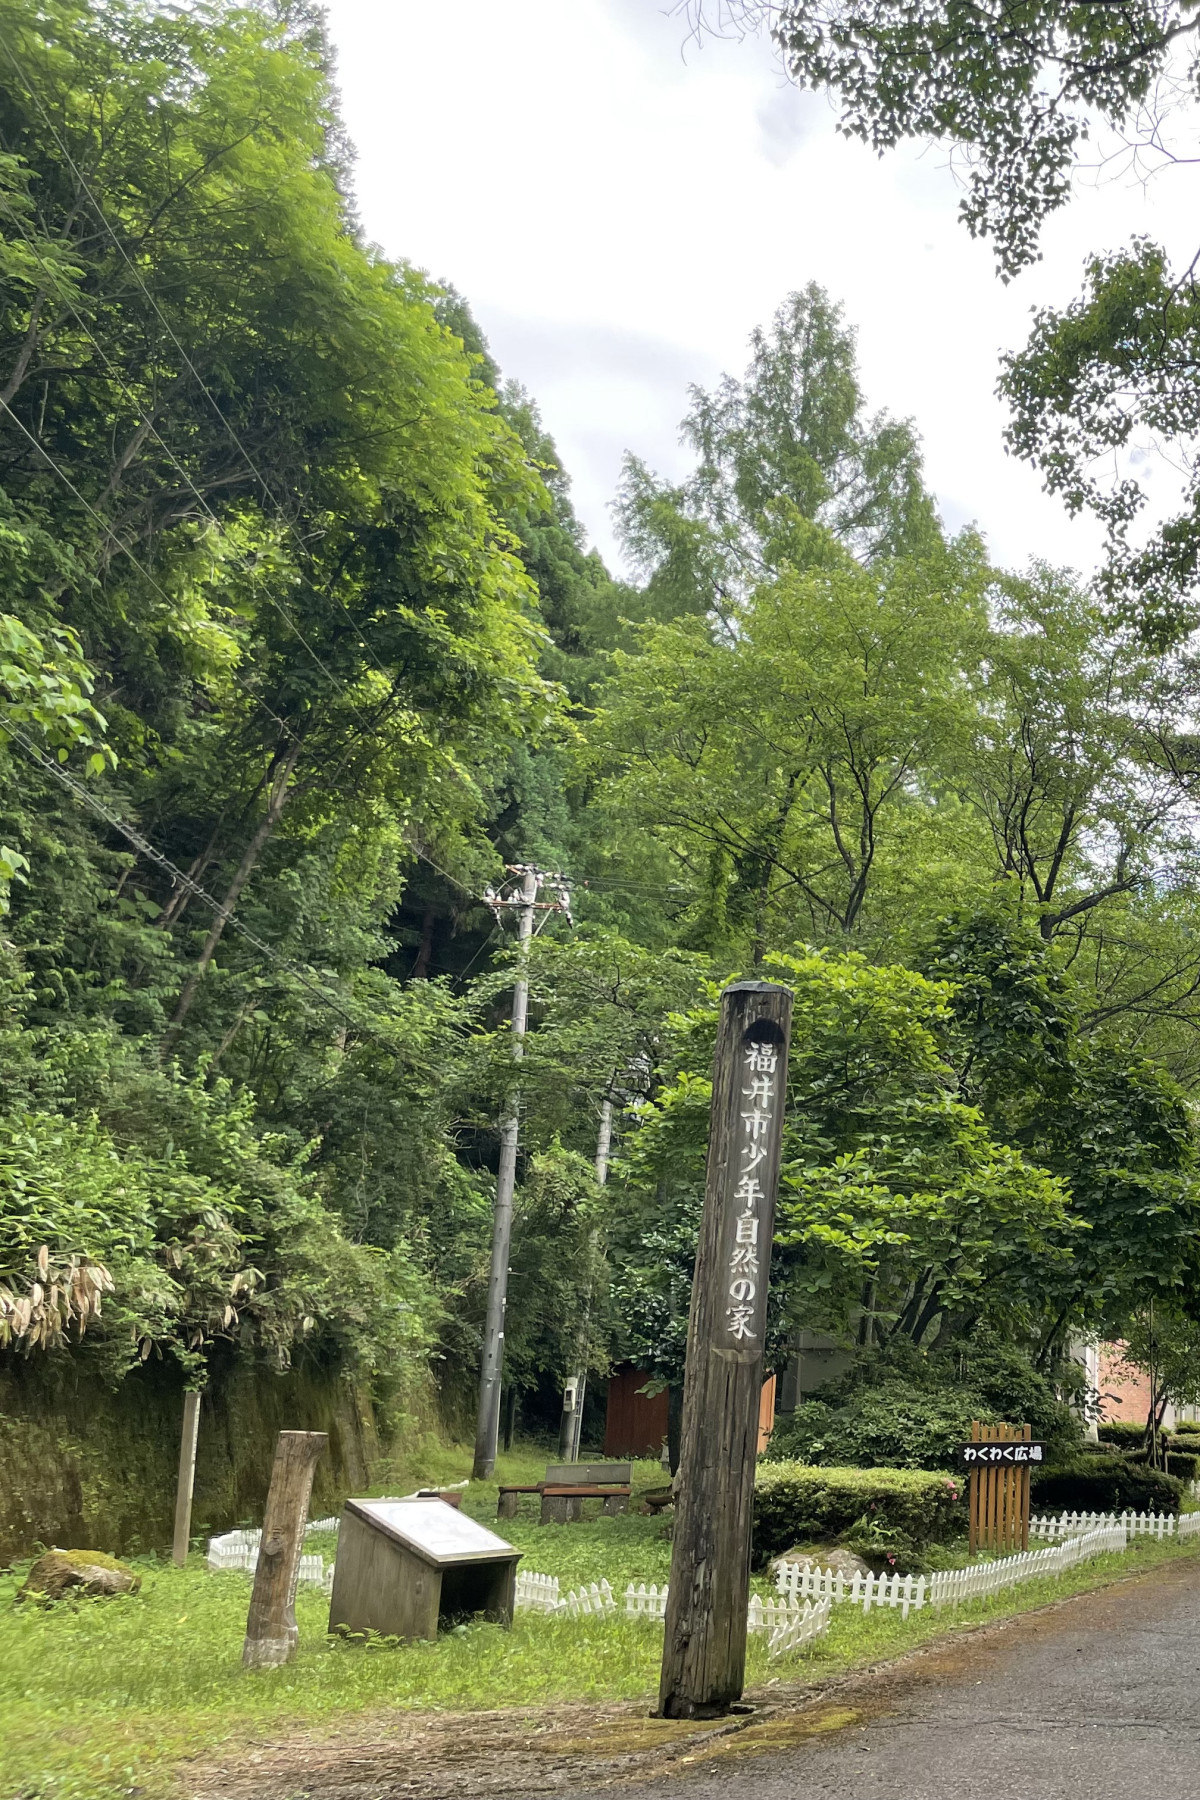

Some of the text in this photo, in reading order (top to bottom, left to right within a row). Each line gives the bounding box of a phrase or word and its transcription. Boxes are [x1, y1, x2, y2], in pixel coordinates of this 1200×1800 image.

[726, 1041, 778, 1340] 福井市少年自然の家
[963, 1445, 1043, 1461] わくわく広場
